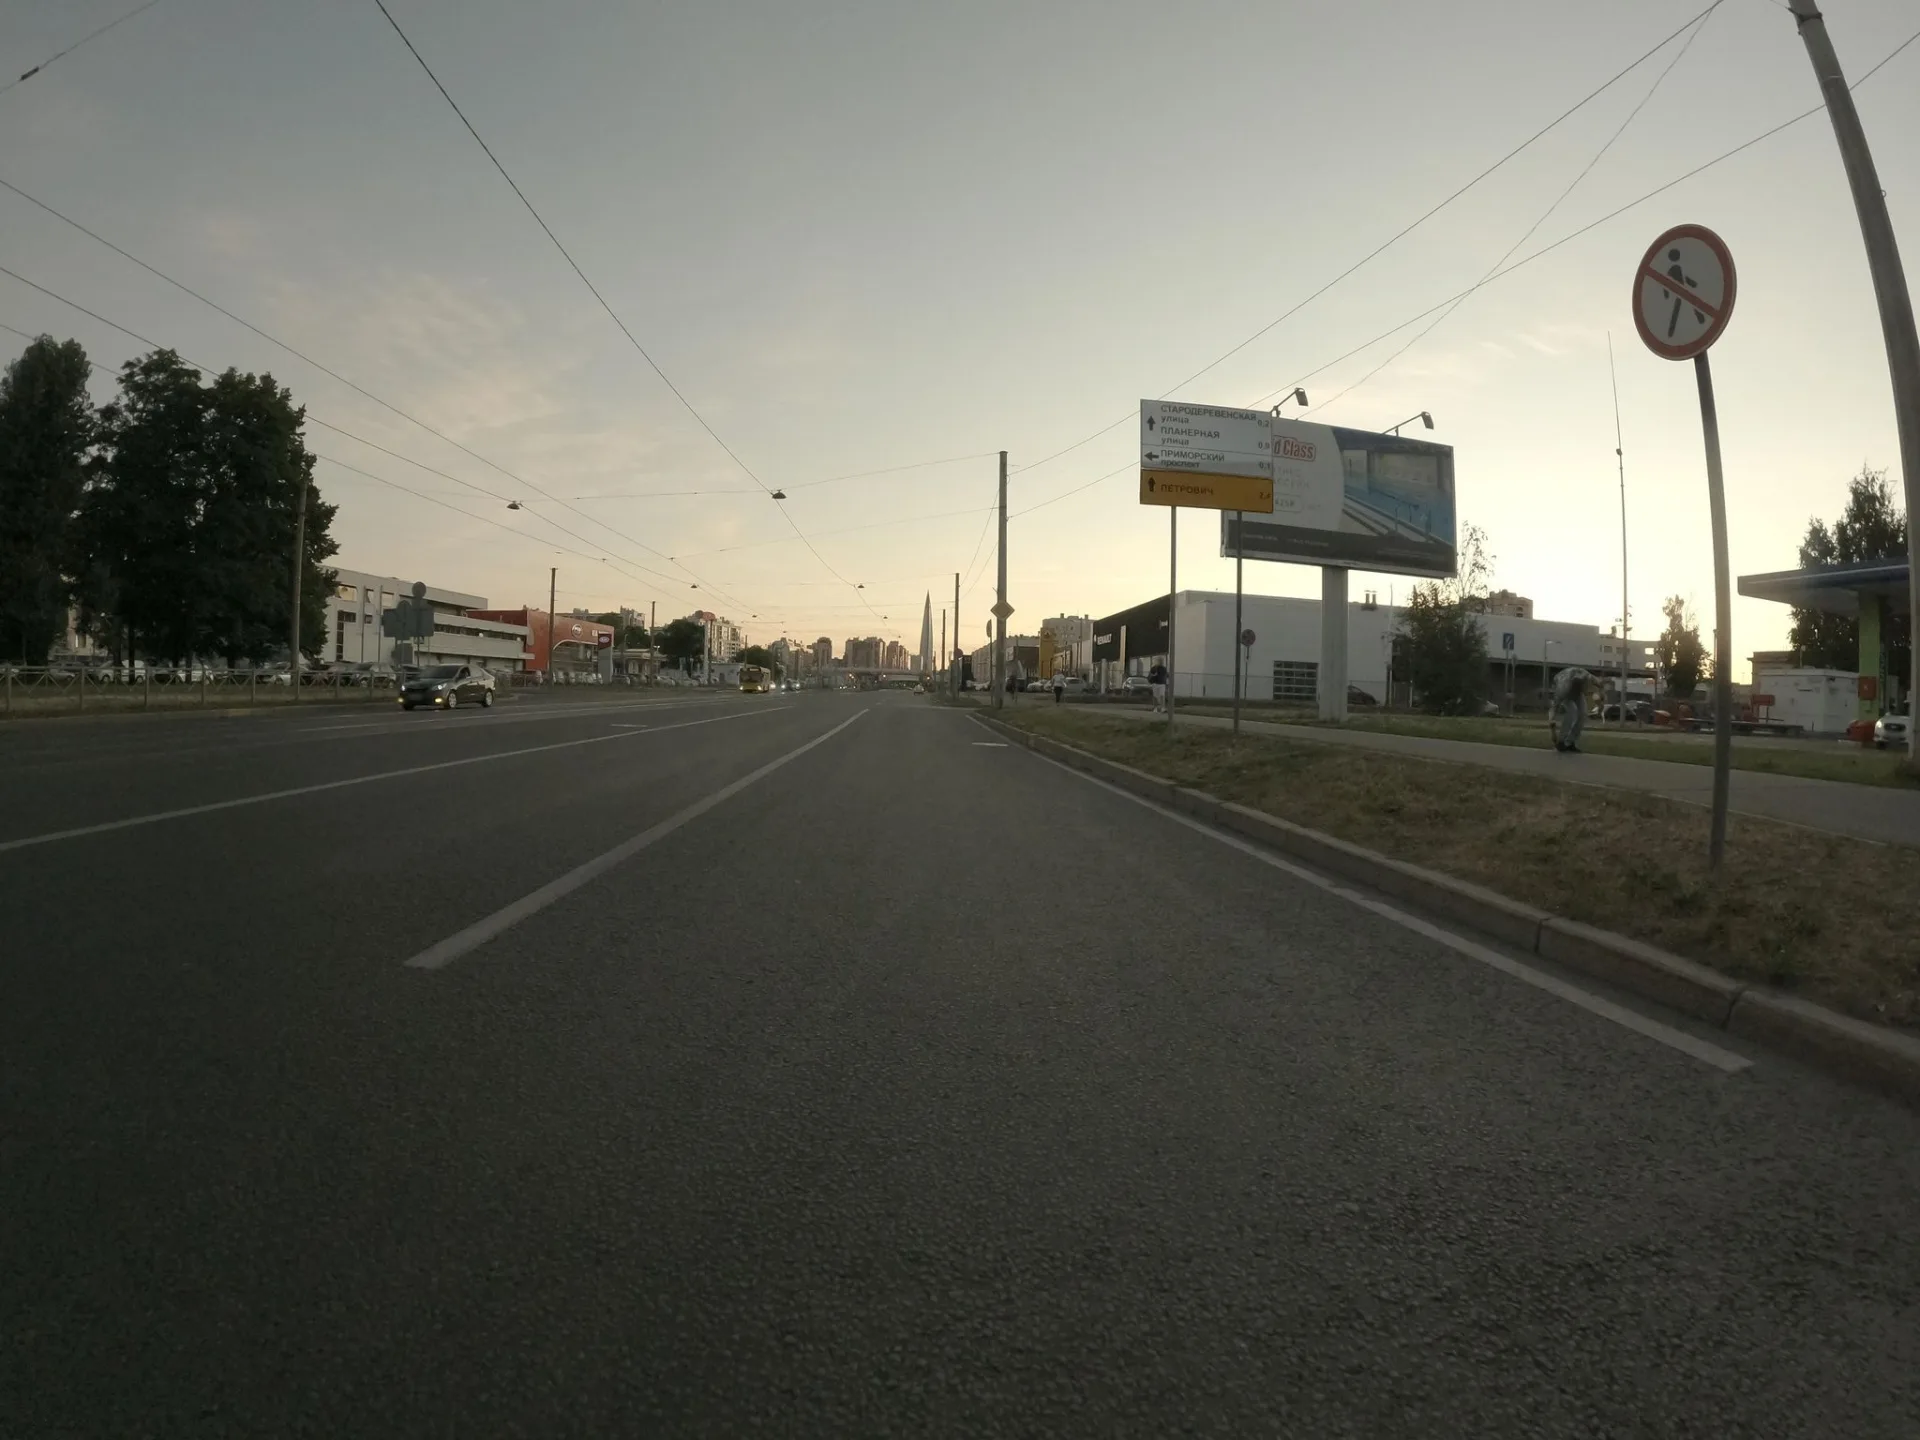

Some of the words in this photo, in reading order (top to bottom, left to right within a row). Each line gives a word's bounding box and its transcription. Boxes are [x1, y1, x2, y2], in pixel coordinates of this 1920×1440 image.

[1161, 404, 1256, 421] СТАРОДЕРЕВЕНСКАЯ
[1161, 415, 1189, 425] улица
[1161, 427, 1220, 439] ПЛАНЕРНАЯ
[1161, 437, 1189, 446] улица
[1283, 439, 1314, 460] Class
[1161, 450, 1225, 462] ПРИМОРСКИЙ
[1161, 460, 1200, 469] проспект
[1161, 484, 1214, 496] ПЕТРОВИЧ
